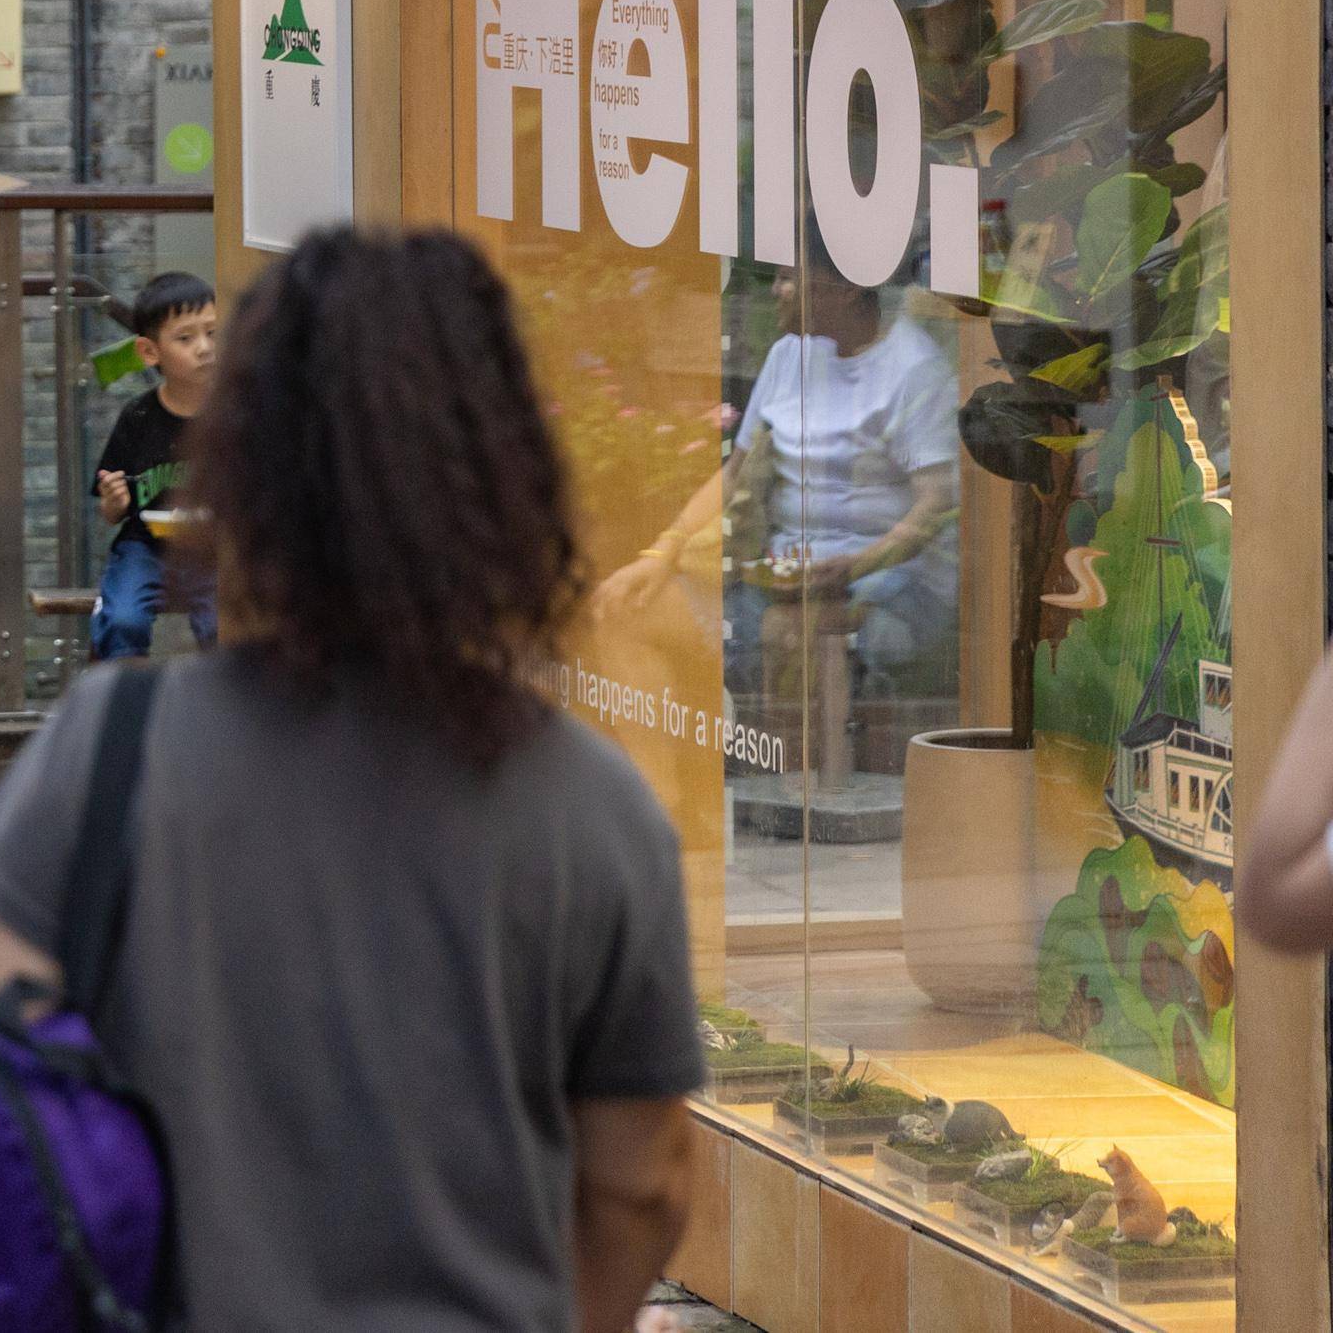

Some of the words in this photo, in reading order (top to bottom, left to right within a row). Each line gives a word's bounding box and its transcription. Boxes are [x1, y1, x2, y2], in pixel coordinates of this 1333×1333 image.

[263, 22, 321, 54] CHONGQING
[593, 76, 640, 111] happens
[598, 127, 611, 150] for
[612, 135, 619, 151] a
[598, 157, 630, 180] reason
[576, 657, 657, 729] happens
[661, 686, 689, 740] for
[695, 709, 708, 747] a
[713, 715, 785, 775] reason
